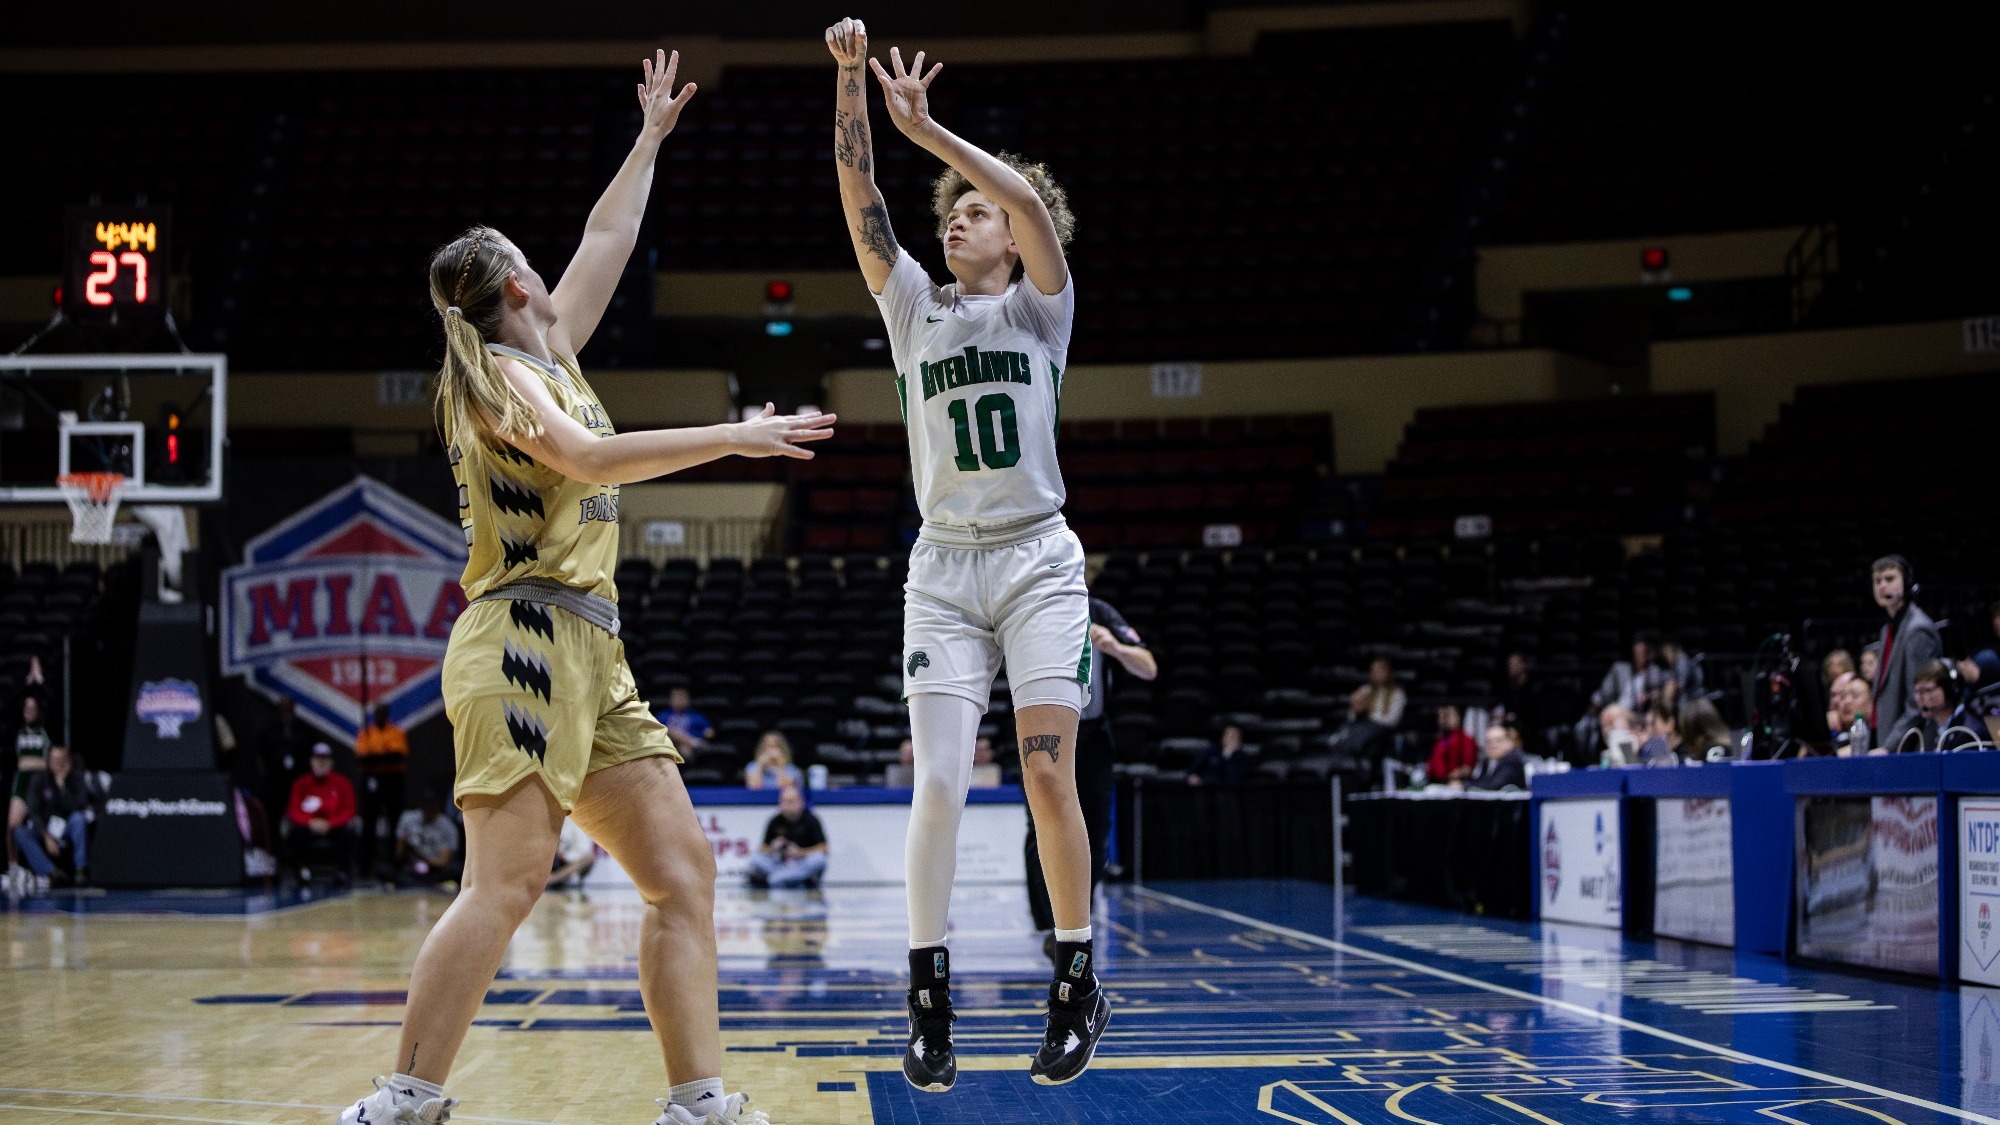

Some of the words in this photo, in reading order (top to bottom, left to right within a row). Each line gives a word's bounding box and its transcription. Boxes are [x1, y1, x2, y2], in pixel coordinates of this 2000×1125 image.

[96, 221, 157, 252] 4:44
[86, 251, 148, 306] 27
[948, 393, 1021, 471] 10
[248, 574, 470, 646] MIAA
[1968, 821, 2000, 853] NTDF
